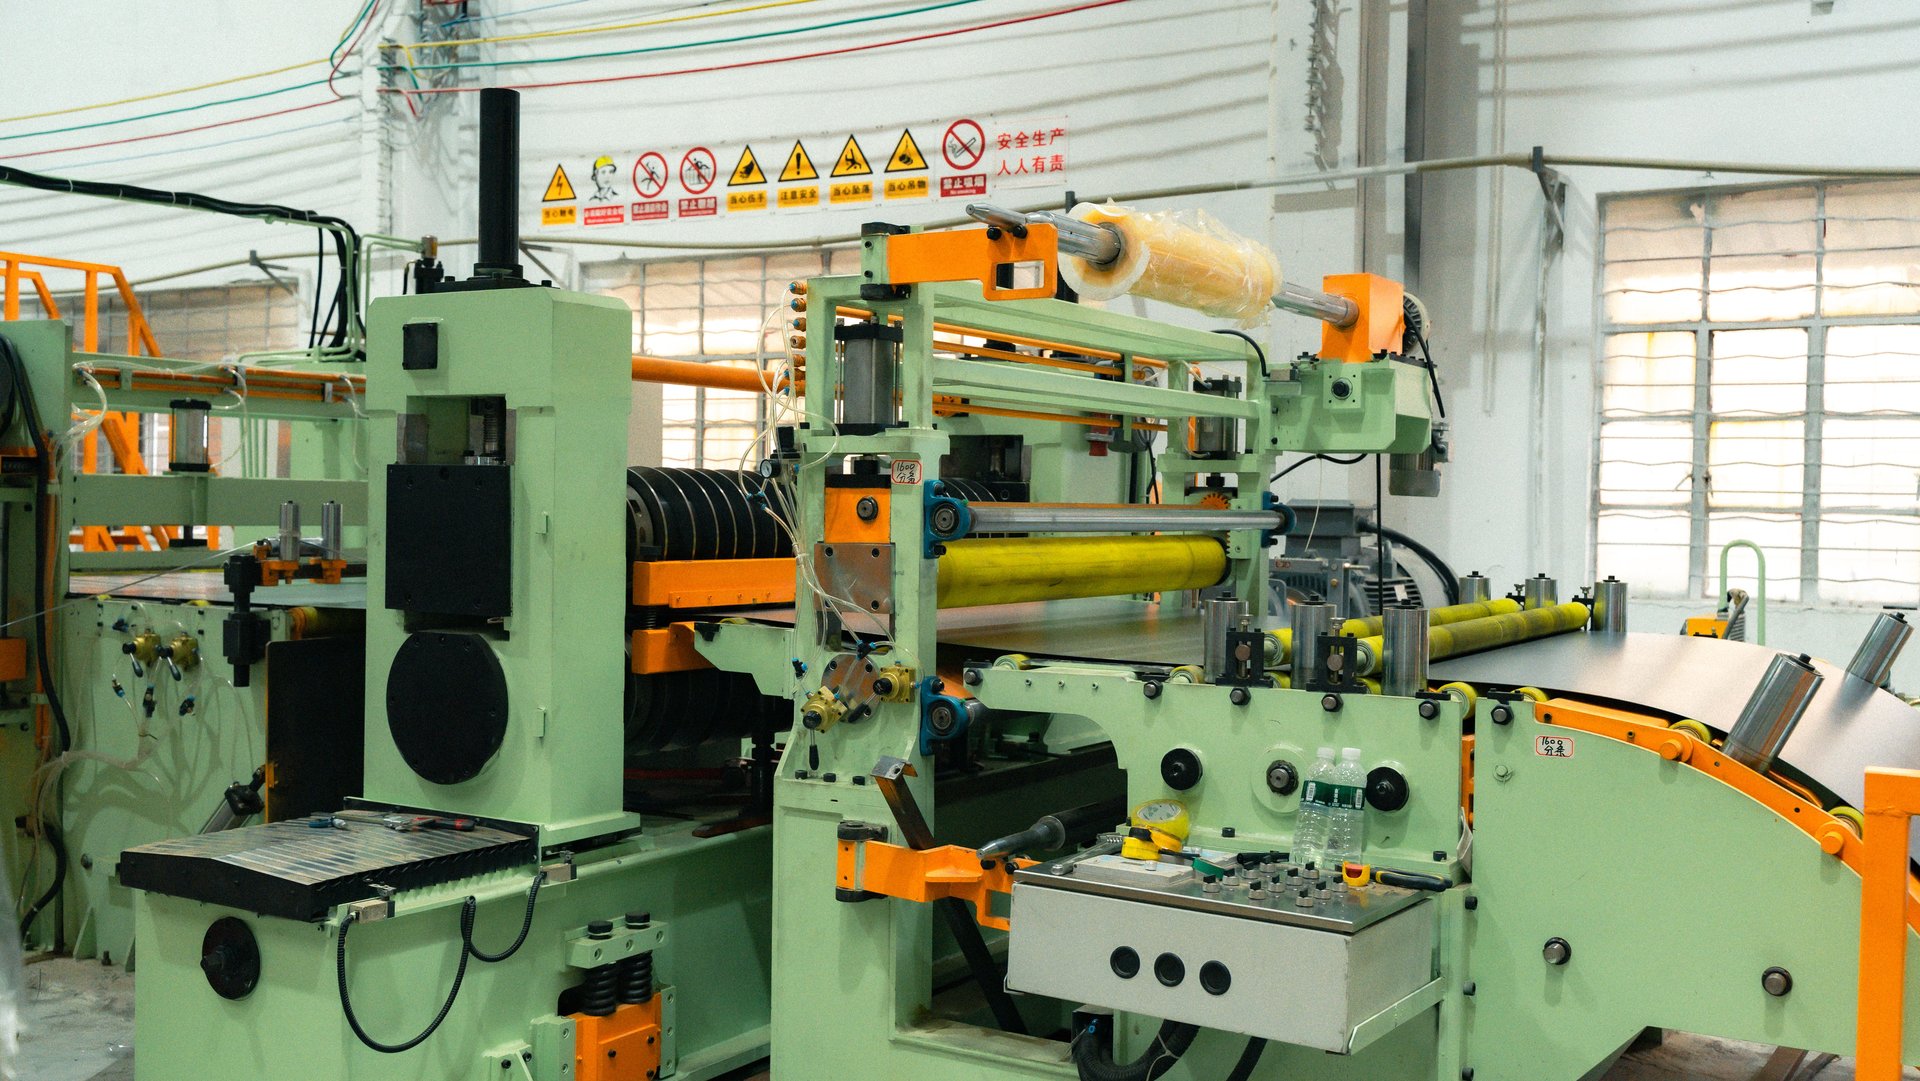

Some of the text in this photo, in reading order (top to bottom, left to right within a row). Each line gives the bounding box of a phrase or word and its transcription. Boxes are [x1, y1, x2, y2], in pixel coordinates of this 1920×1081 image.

[997, 128, 1065, 150] 安全生产
[997, 154, 1064, 176] 人人有责
[833, 183, 870, 196] 当心坠落
[887, 179, 927, 192] 当心吊物
[780, 188, 817, 201] 注意安全
[896, 462, 915, 472] 1600
[1541, 736, 1563, 746] 1600
